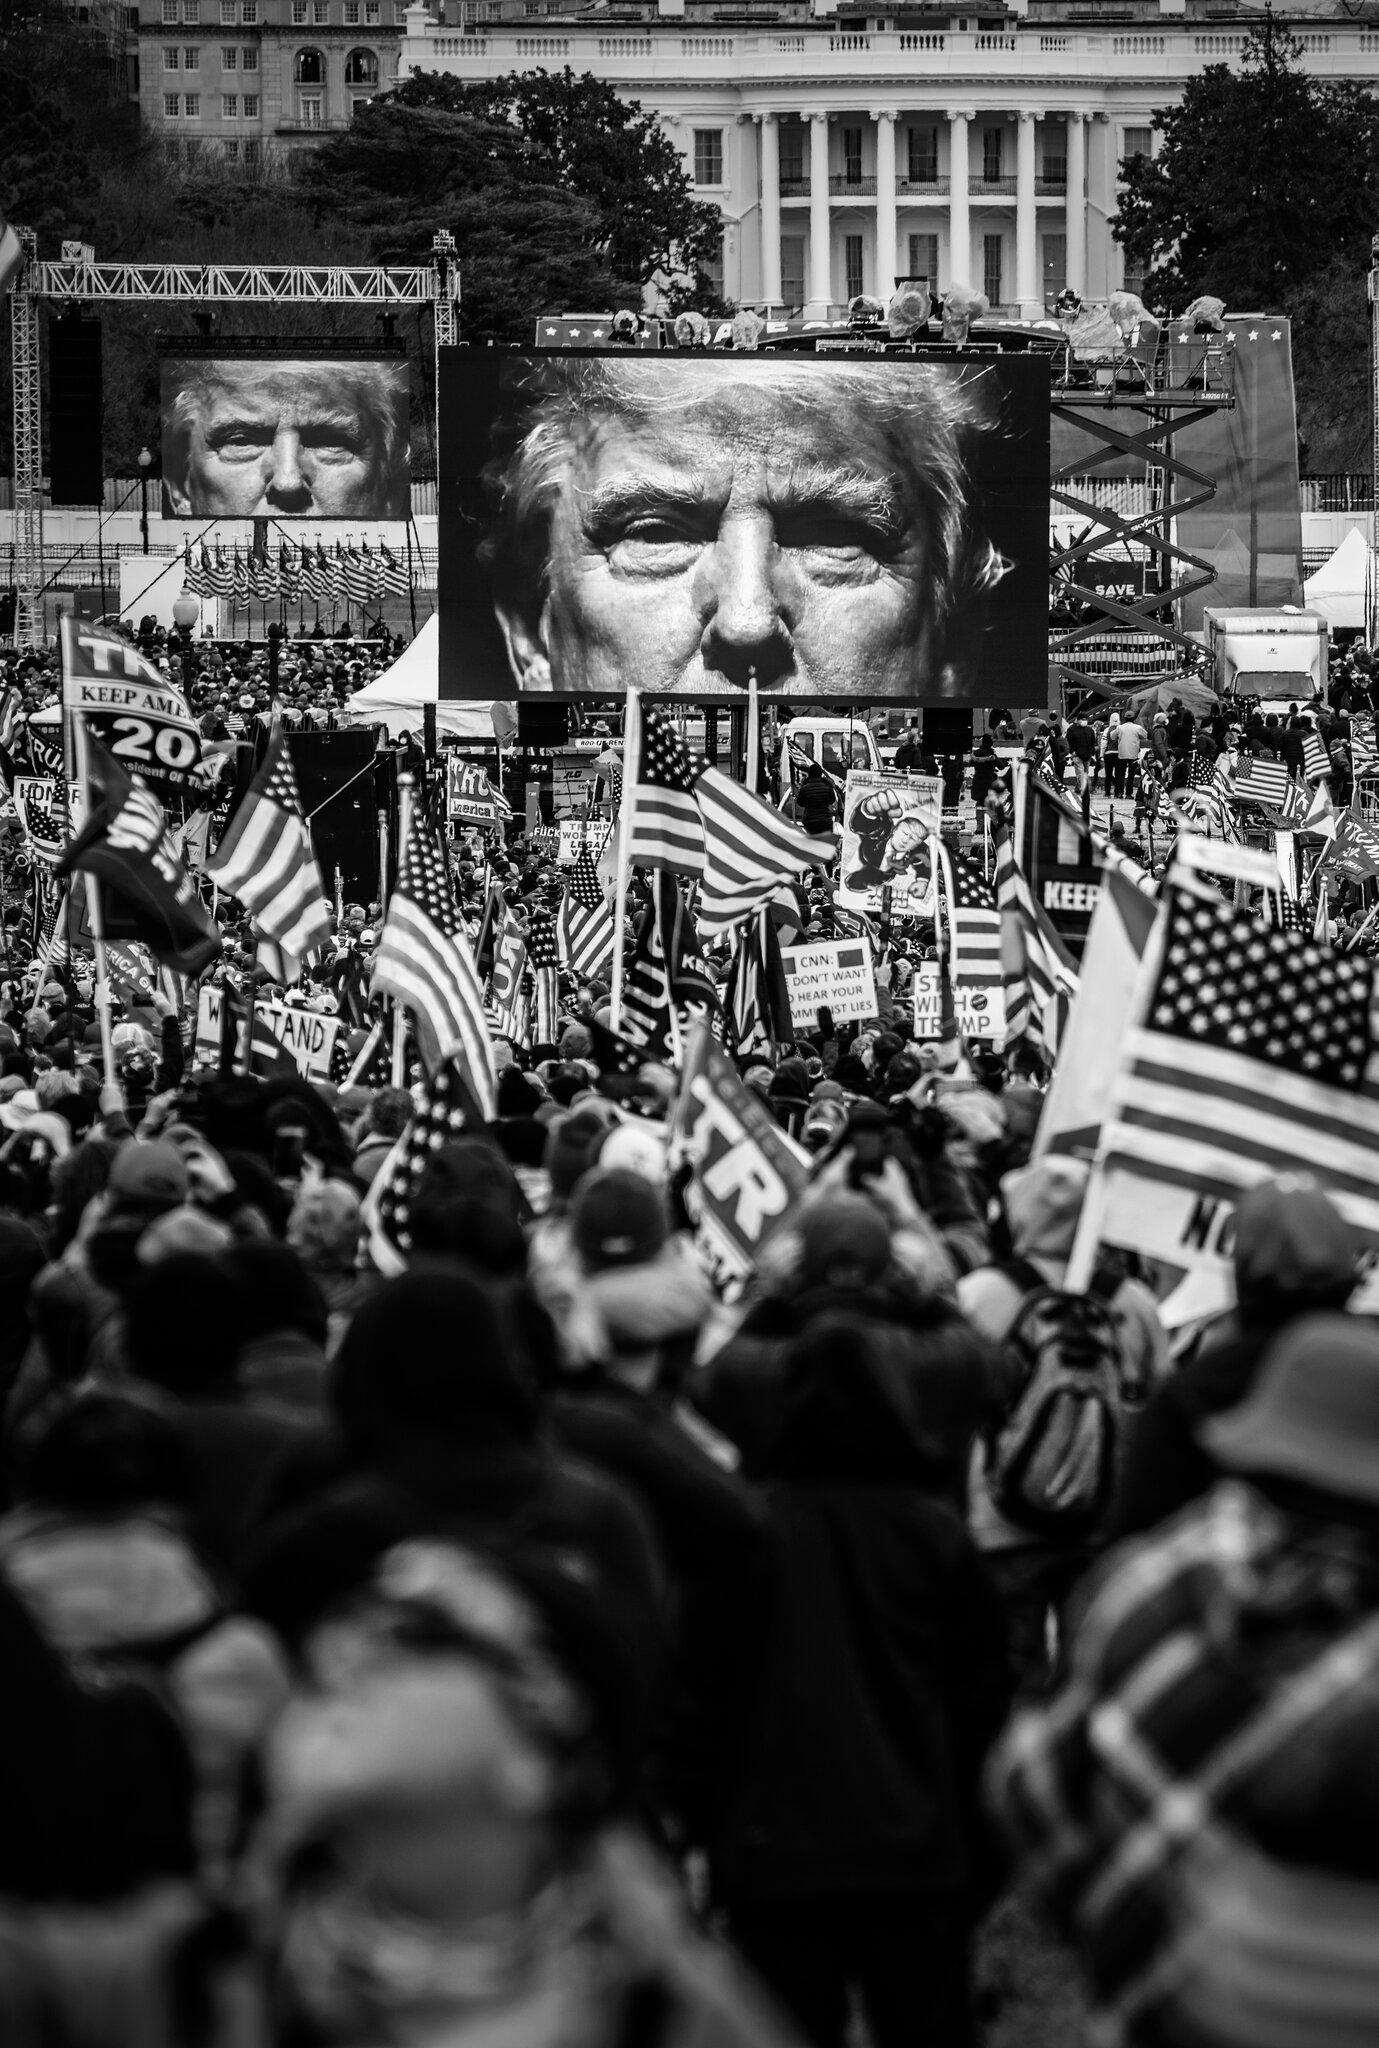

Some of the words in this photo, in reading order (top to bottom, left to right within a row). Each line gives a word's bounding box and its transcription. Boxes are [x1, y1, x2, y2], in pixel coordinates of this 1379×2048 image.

[1095, 584, 1136, 597] SAVE
[81, 686, 137, 705] KEEP
[123, 761, 166, 779] sident
[563, 770, 582, 780] JLG
[534, 825, 560, 838] FUCK
[1043, 880, 1101, 912] KEEP
[800, 954, 834, 968] CNN:
[792, 972, 829, 987] DON'T
[832, 968, 867, 982] WANT
[797, 990, 829, 1003] HEAR
[831, 985, 863, 998] YOUR
[850, 1000, 873, 1012] LIES
[916, 994, 967, 1013] WIH
[917, 1016, 991, 1034] TRMP
